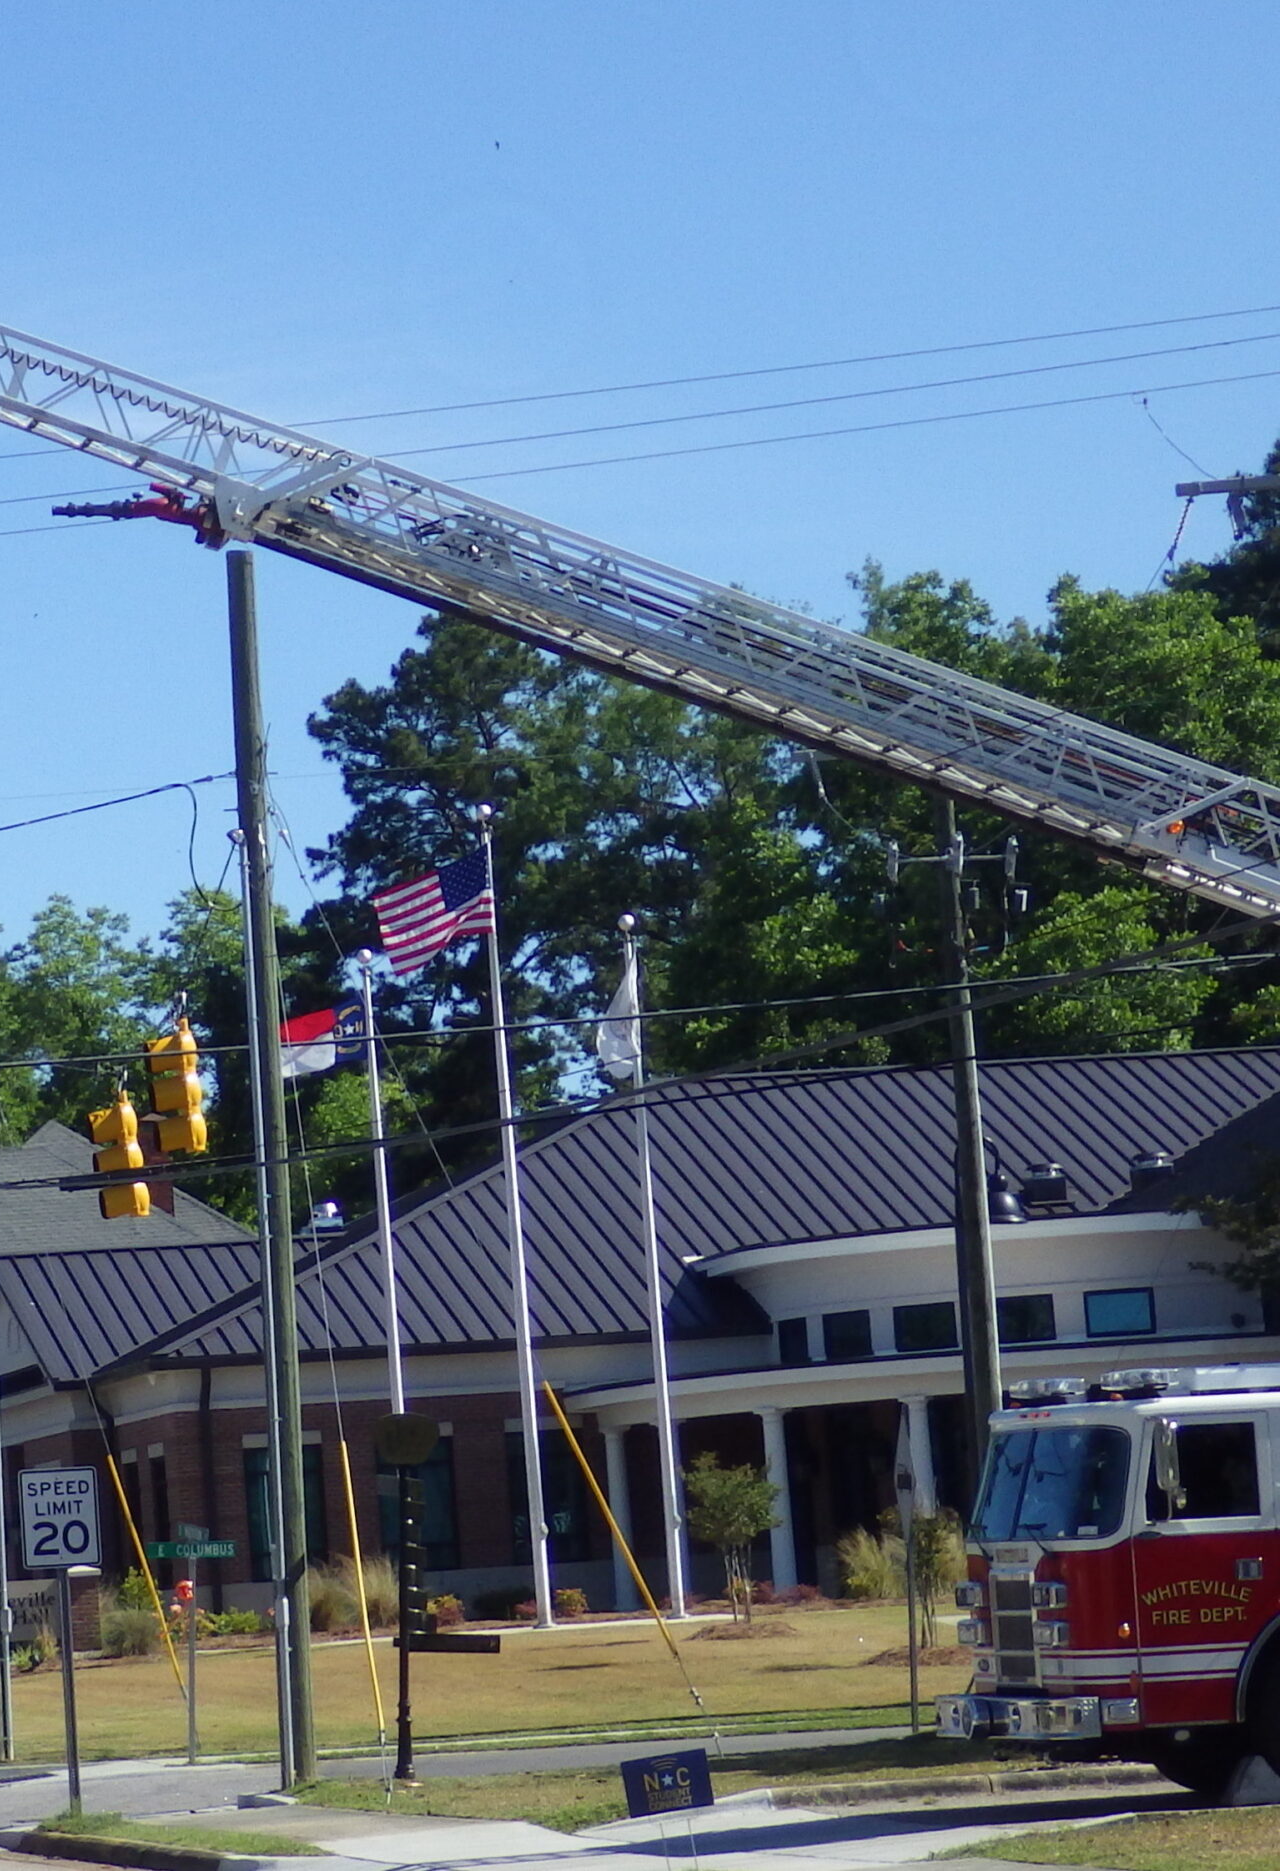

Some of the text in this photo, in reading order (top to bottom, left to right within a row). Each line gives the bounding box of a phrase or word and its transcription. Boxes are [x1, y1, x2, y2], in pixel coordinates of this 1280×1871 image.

[27, 1480, 90, 1497] SPEED
[34, 1500, 83, 1517] LIMIT
[32, 1520, 90, 1556] 20
[158, 1543, 235, 1558] E COLUMBUS
[1141, 1580, 1252, 1605] WHITEVILLE
[1152, 1606, 1248, 1625] FIRE DEPT.
